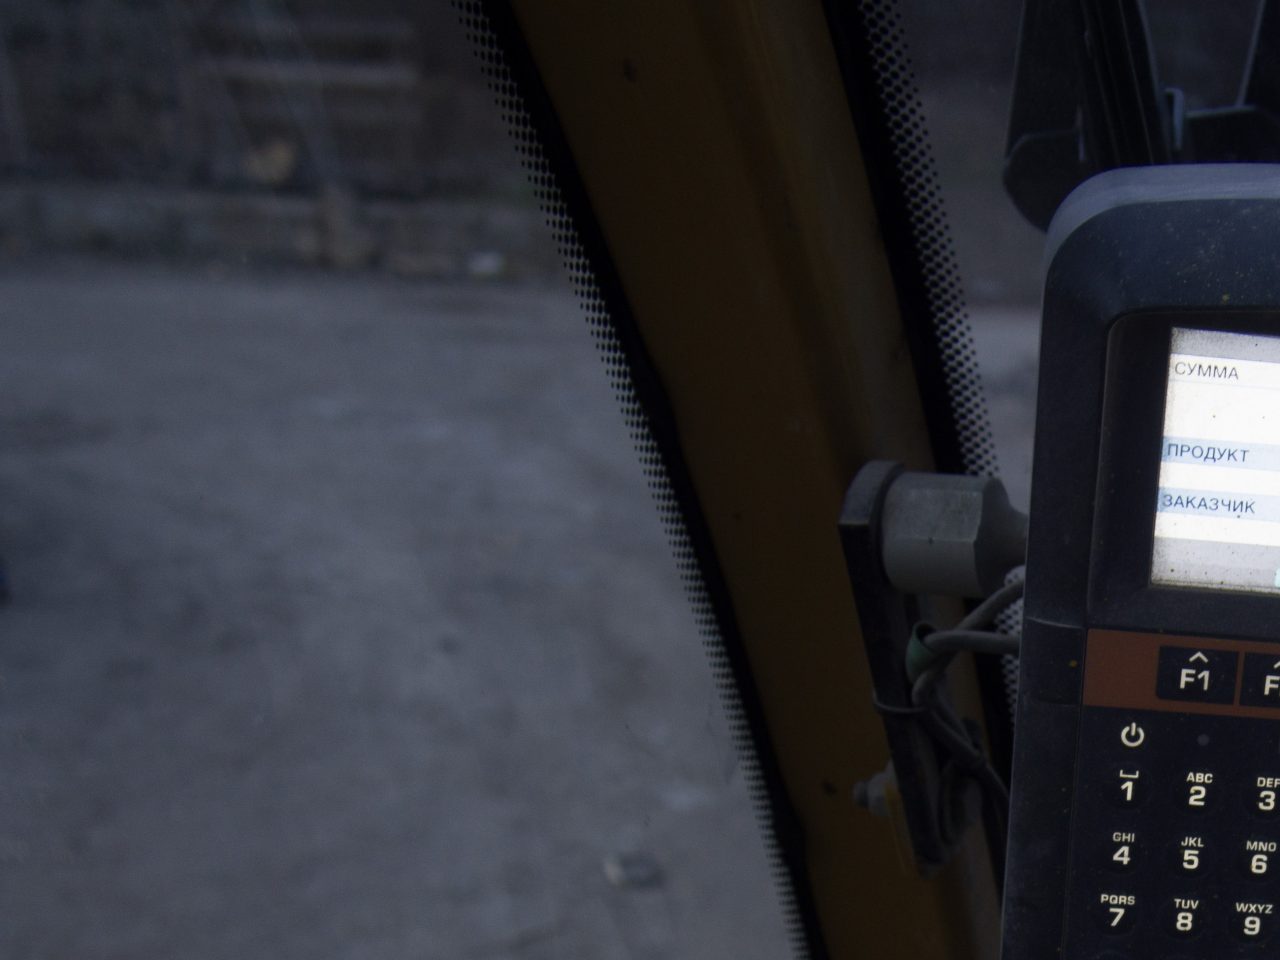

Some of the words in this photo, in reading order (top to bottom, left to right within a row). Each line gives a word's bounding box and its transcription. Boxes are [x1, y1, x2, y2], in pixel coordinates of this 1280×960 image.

[1174, 361, 1239, 380] СУММА
[1166, 442, 1250, 463] ПРОДУКТ
[1162, 494, 1256, 514] ЗАКАЗЧИК
[1179, 668, 1210, 691] F1
[1186, 772, 1213, 784] ABC
[1120, 781, 1134, 801] 1
[1188, 787, 1206, 806] 2
[1257, 791, 1276, 811] 3
[1112, 832, 1135, 843] GHI
[1181, 836, 1204, 848] JKL
[1246, 841, 1277, 852] MNO
[1112, 845, 1131, 865] 4
[1182, 850, 1200, 870] 5
[1250, 854, 1268, 874] 6
[1100, 894, 1136, 906] PQRS
[1174, 898, 1199, 910] TUV
[1235, 902, 1273, 914] WXYZ
[1108, 908, 1125, 927] 7
[1175, 912, 1193, 931] 8
[1243, 916, 1261, 936] 9
